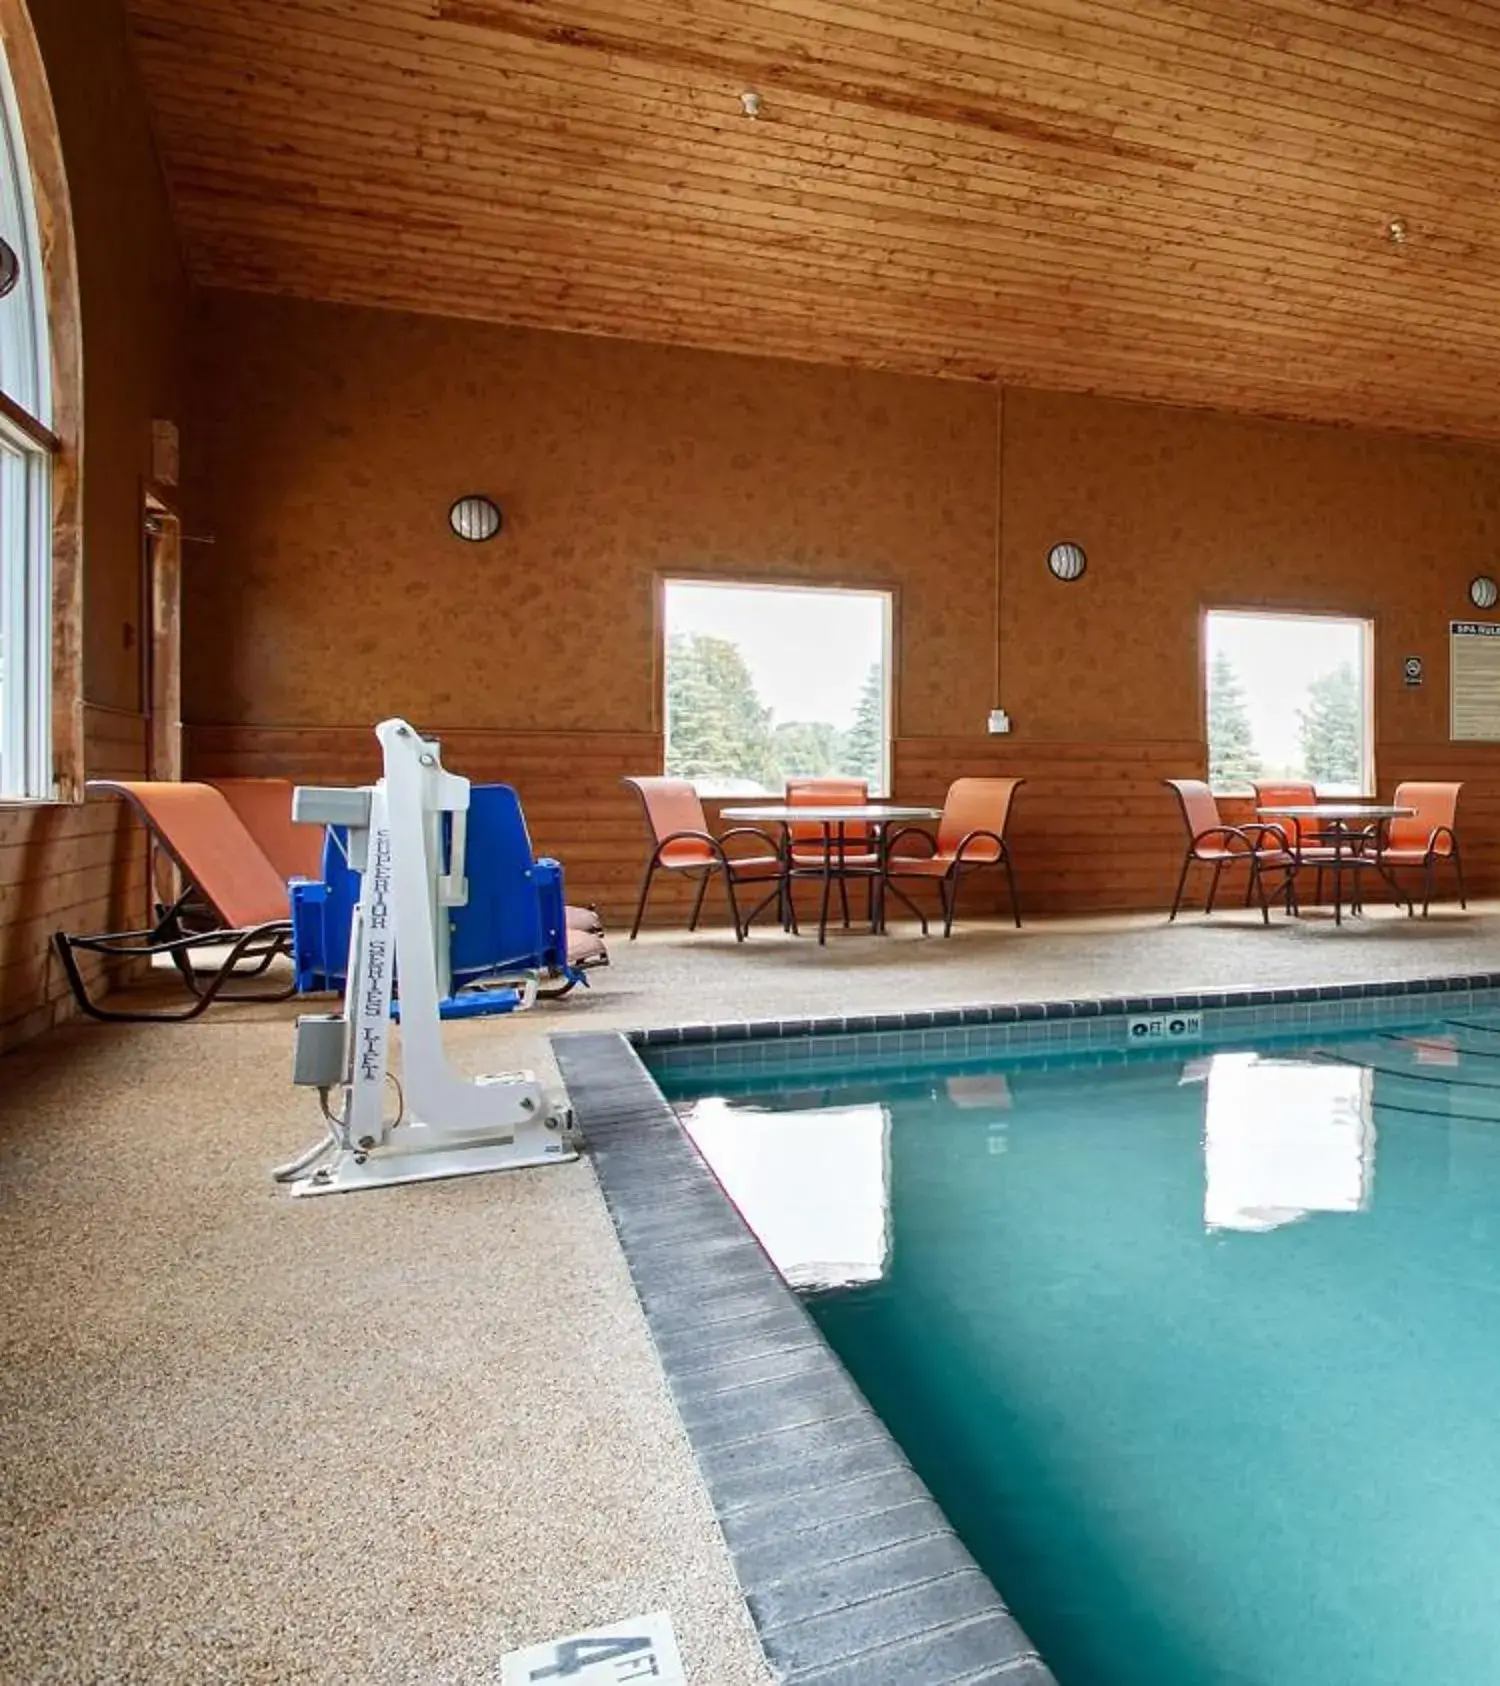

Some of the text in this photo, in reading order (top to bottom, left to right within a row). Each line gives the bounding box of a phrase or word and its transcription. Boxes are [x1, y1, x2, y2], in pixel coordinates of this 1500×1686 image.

[1457, 625, 1476, 634] SPA
[364, 940, 386, 1017] SERIES
[361, 1028, 381, 1081] LIFT
[530, 1636, 660, 1683] 4 FT
